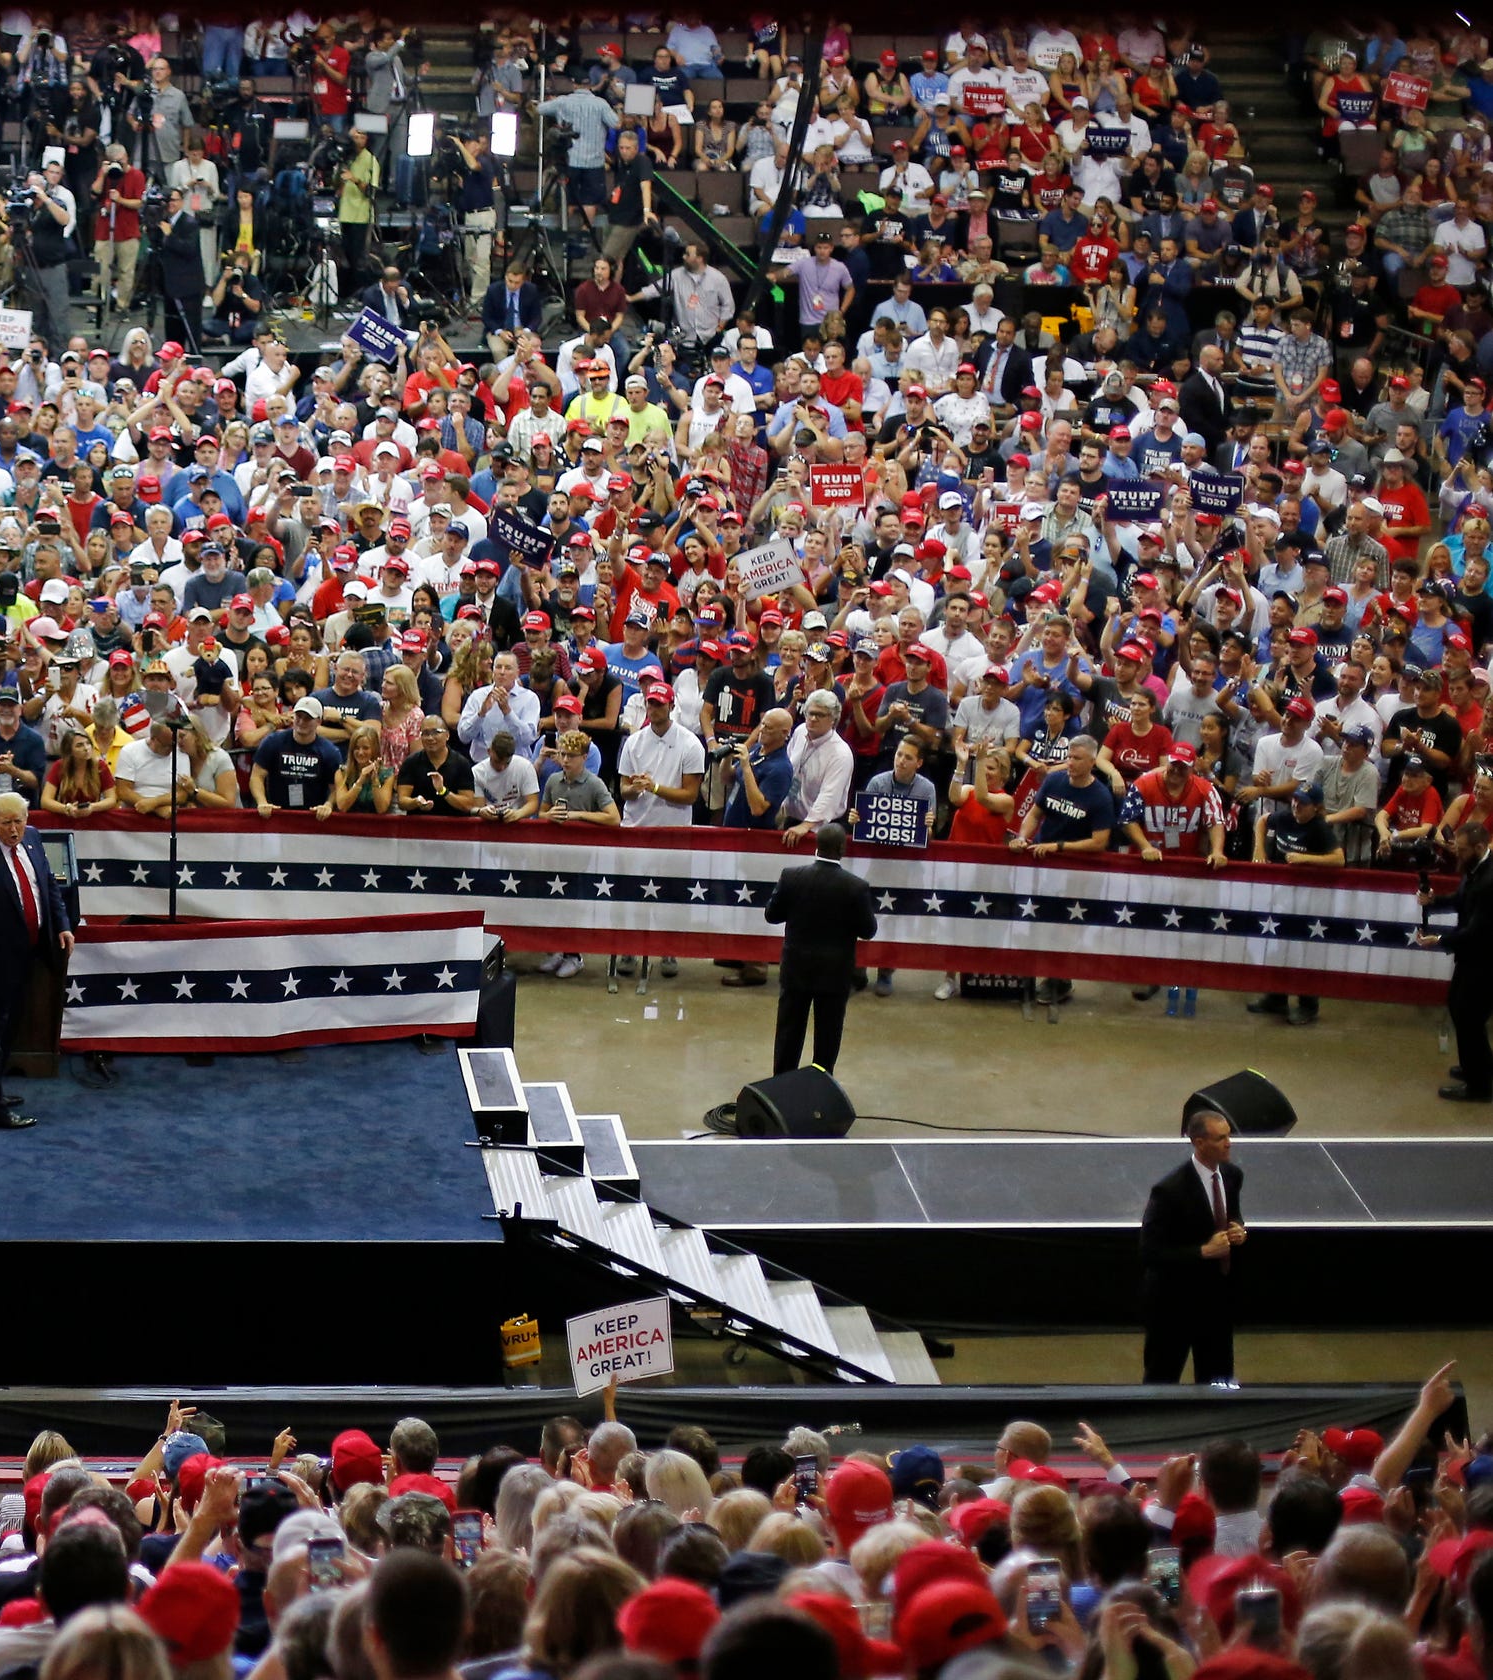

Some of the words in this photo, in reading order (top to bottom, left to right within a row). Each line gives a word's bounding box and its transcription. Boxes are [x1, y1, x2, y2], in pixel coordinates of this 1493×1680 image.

[1390, 78, 1428, 94] TRUMP
[966, 91, 1004, 101] TRUMP
[1339, 99, 1374, 108] TRUMP
[1089, 134, 1128, 144] TRUMP
[360, 315, 403, 346] TRUMP
[812, 473, 862, 485] TRUMP
[823, 488, 852, 499] 2020
[1109, 490, 1161, 501] TRUMP
[1191, 479, 1240, 496] TRUMP
[1200, 496, 1228, 508] 2020
[497, 516, 548, 550] TRUMP
[750, 550, 777, 566] KEEP
[742, 558, 795, 582] AMERICA
[753, 571, 791, 592] GREAT!
[629, 586, 661, 616] Trump
[699, 608, 716, 620] USA
[1317, 644, 1349, 657] RUMP
[282, 754, 319, 767] TRUMP
[872, 796, 918, 813] JOBS!
[1046, 796, 1087, 820] TRUMP
[871, 811, 917, 828] JOBS!
[870, 826, 916, 843] JOBS!
[594, 1315, 639, 1337] KEEP
[502, 1332, 539, 1347] VRU+
[576, 1327, 664, 1364] AMERICA
[589, 1350, 652, 1378] GREAT!
